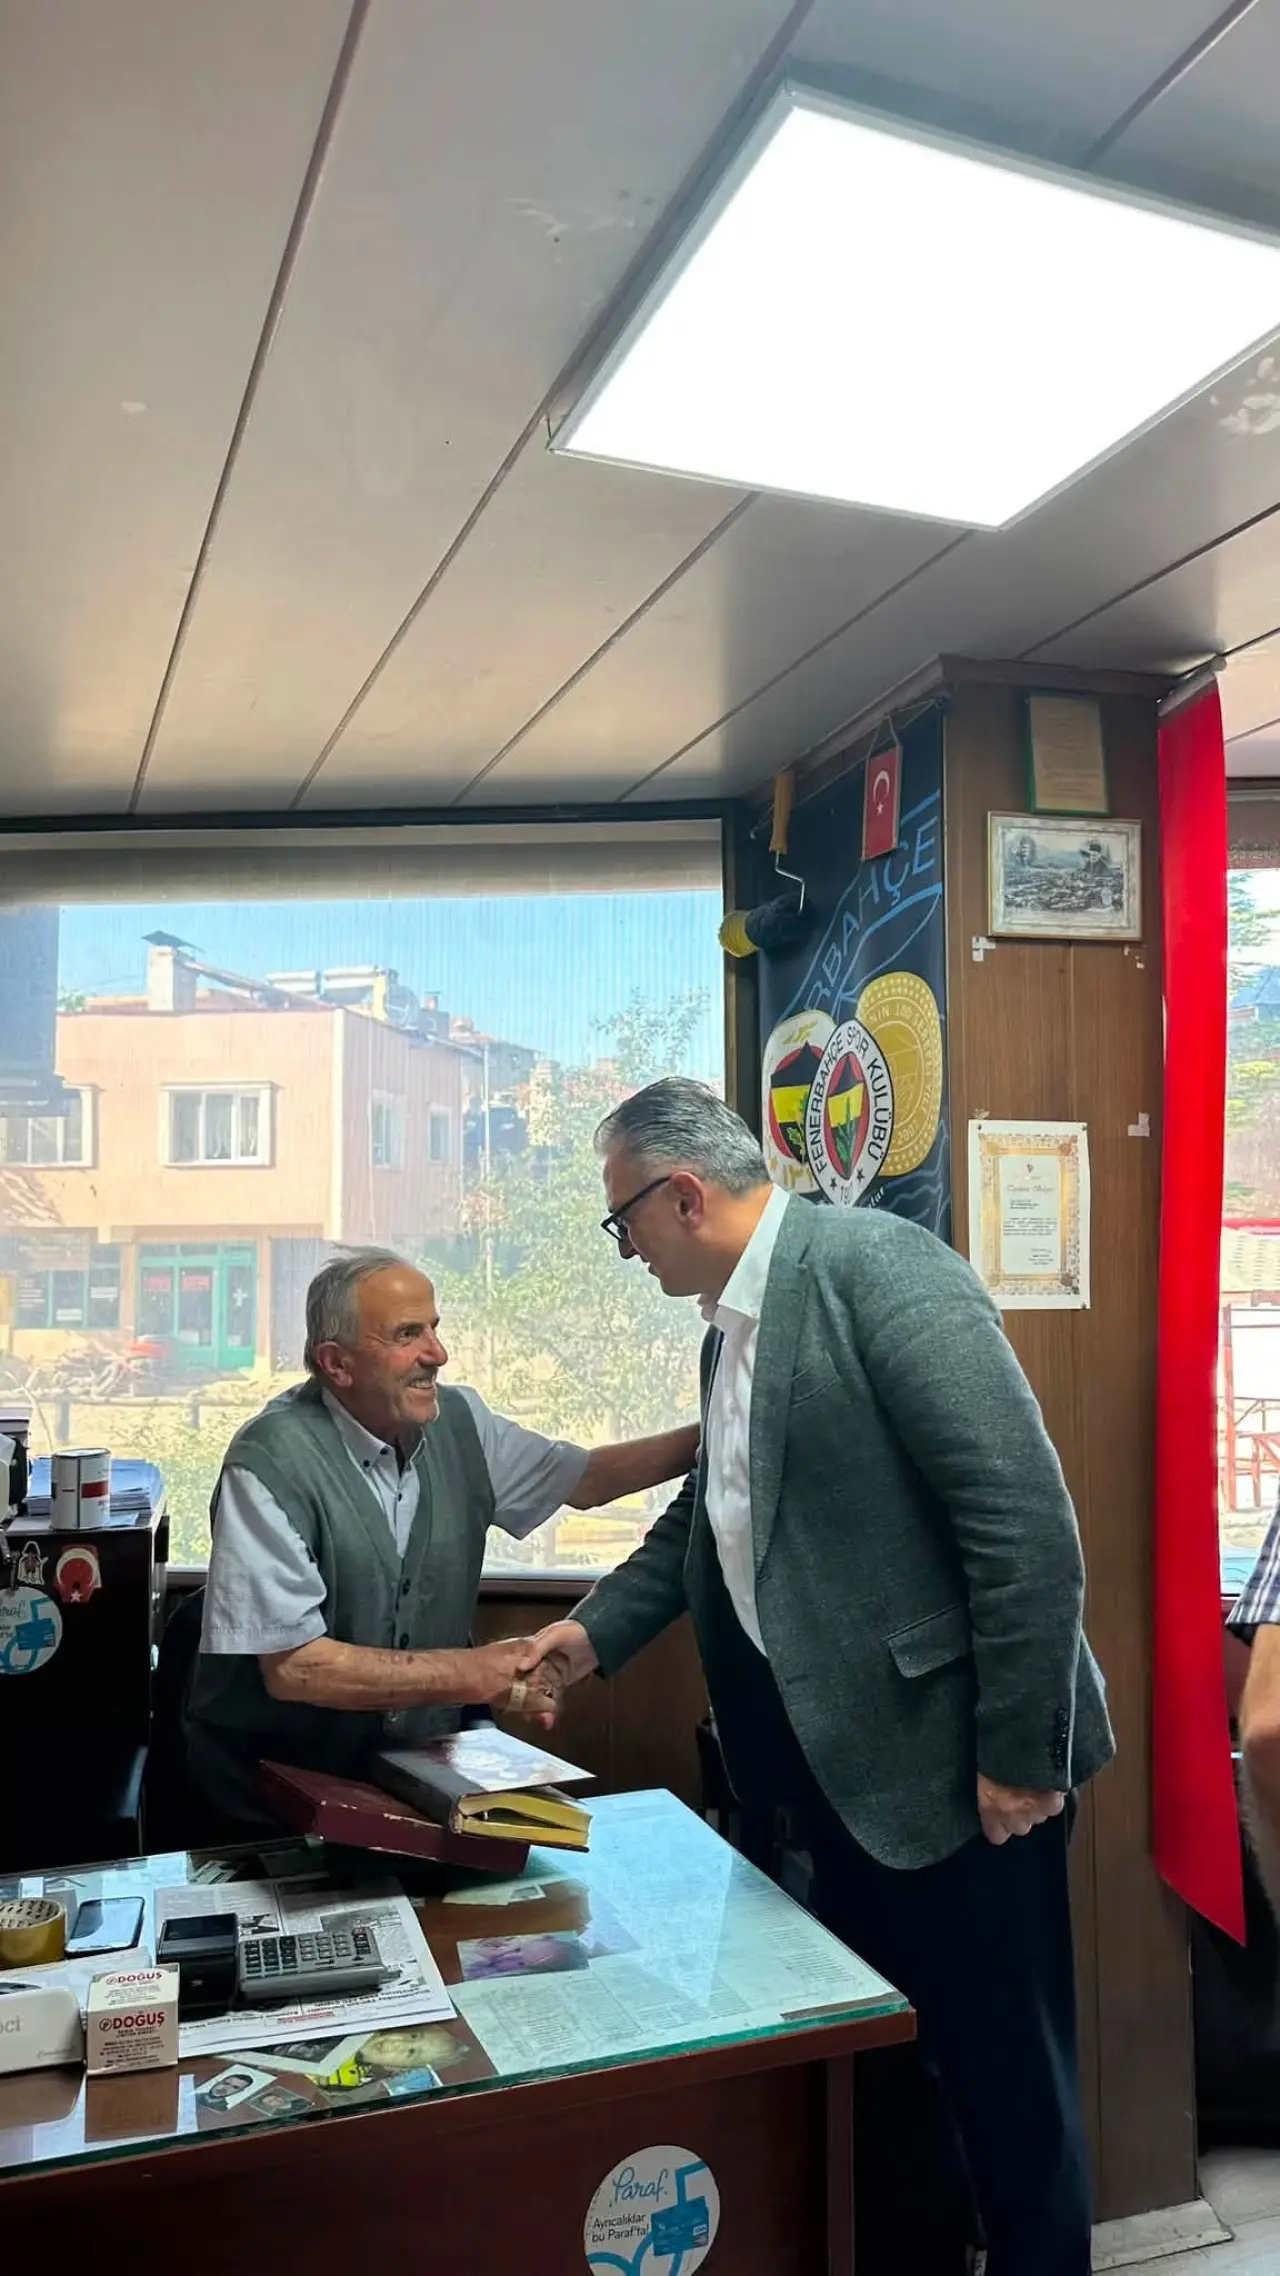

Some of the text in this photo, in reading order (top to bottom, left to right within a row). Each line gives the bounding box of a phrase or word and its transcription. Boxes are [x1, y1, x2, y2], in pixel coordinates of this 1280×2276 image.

[810, 1025, 893, 1175] FENERBAHÇE SPOR KULÜBÜ
[112, 2009, 166, 2028] DOĞUŞ
[591, 2231, 606, 2243] bu
